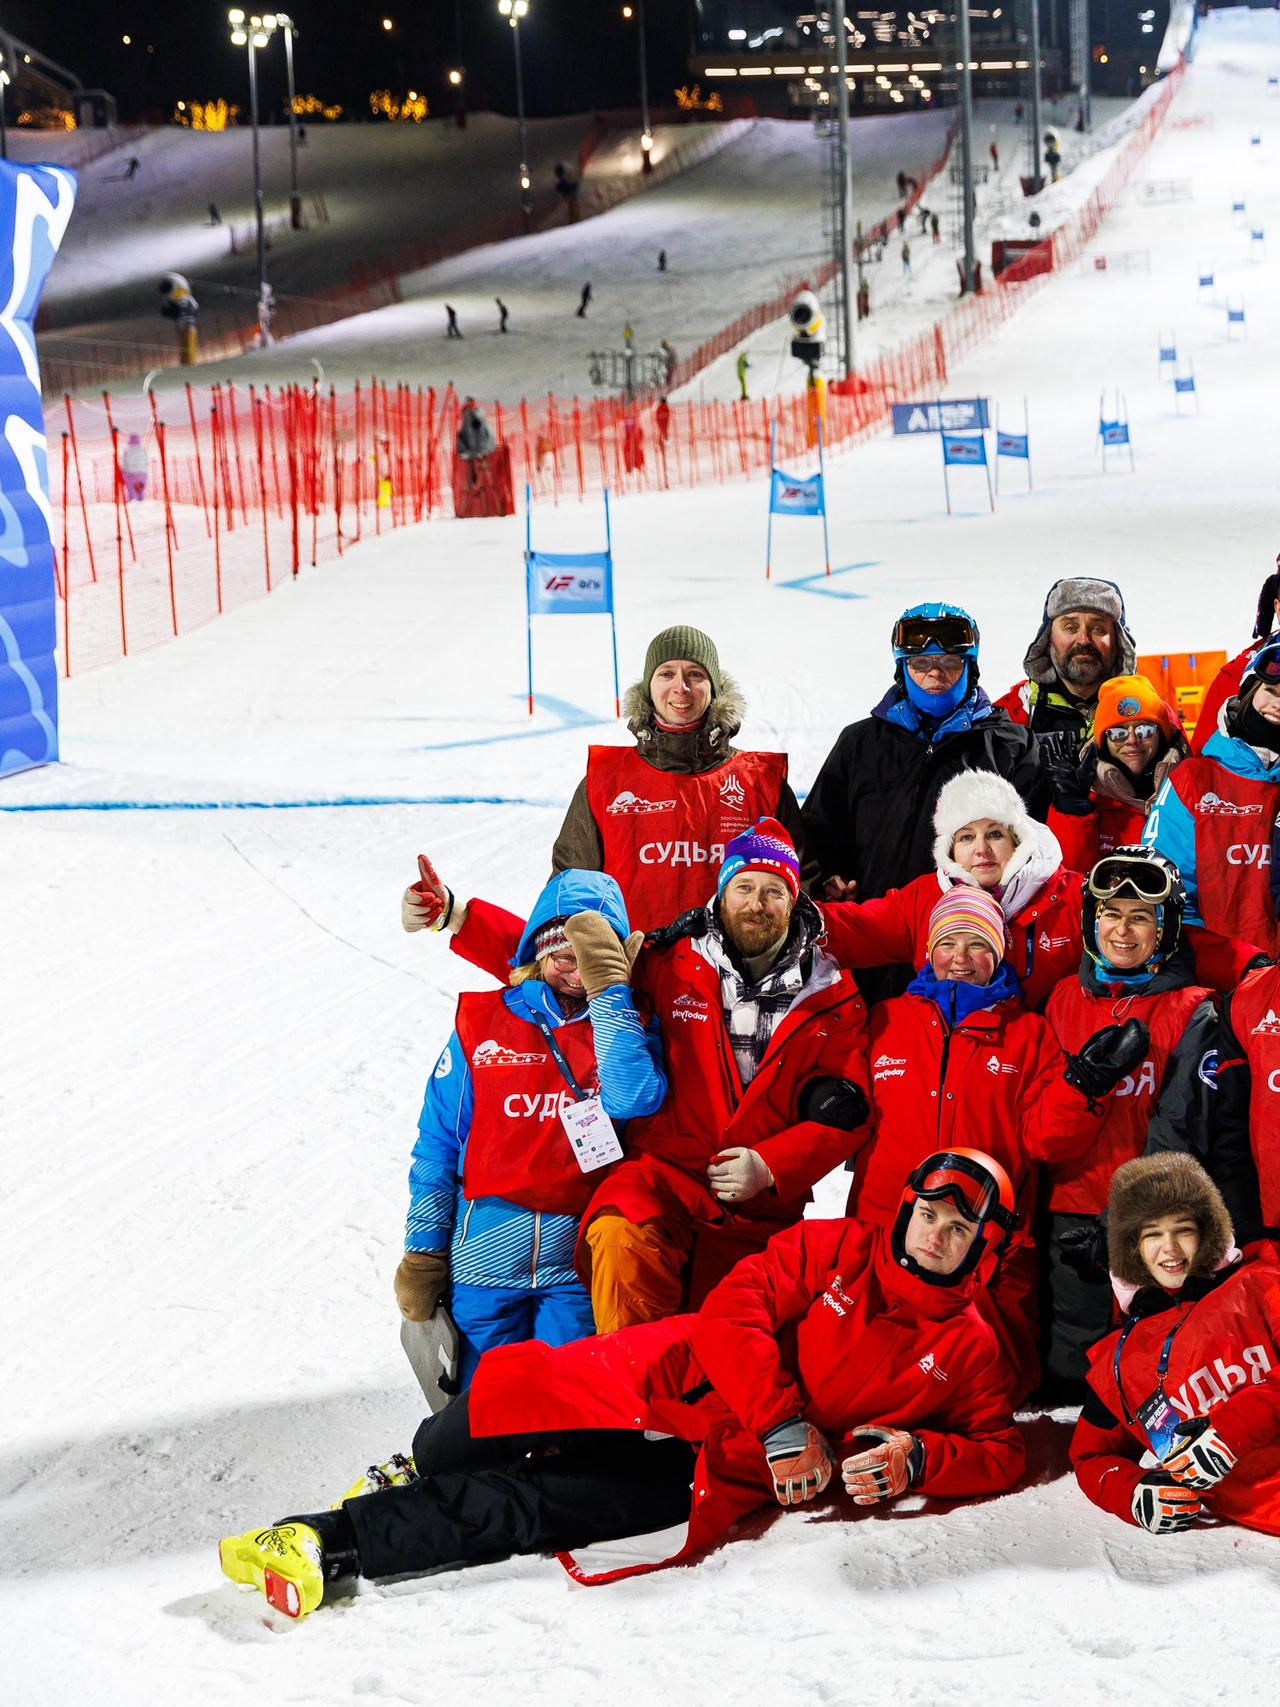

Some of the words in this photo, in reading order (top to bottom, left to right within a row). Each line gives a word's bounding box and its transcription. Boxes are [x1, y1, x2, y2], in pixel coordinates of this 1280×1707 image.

[639, 841, 725, 868] СУДЬЯ
[749, 857, 781, 868] SKI
[1226, 844, 1272, 869] СУД
[1169, 1344, 1272, 1419] УДЬЯ
[1163, 1488, 1193, 1499] reusch
